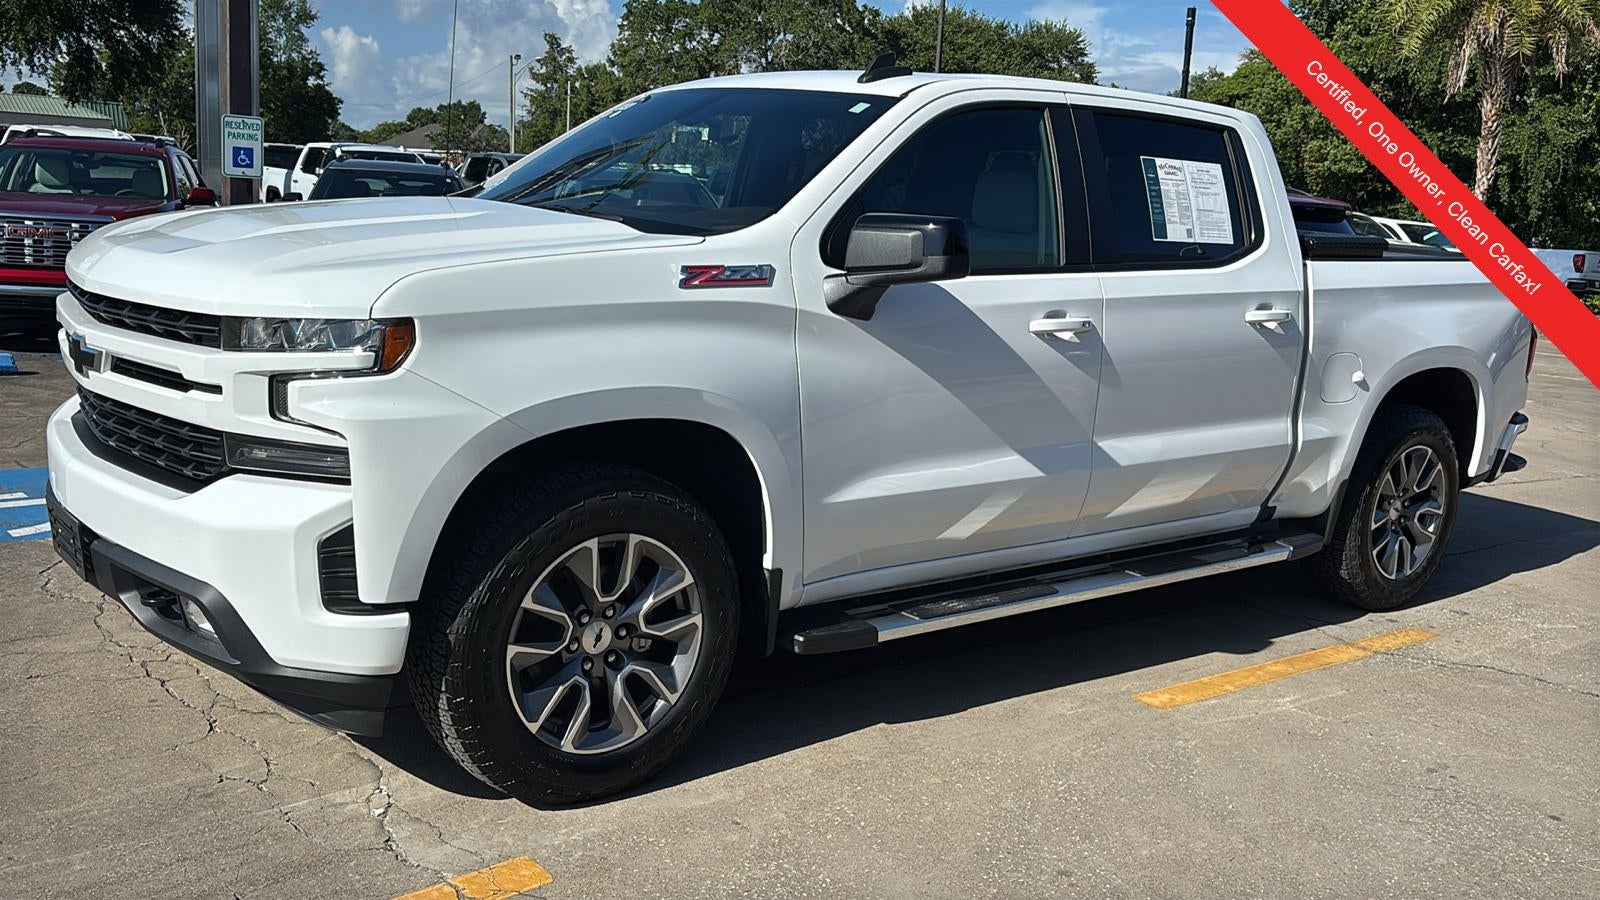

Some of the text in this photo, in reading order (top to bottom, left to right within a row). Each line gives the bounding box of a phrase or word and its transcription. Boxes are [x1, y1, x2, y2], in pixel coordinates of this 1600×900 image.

[225, 121, 260, 131] RESERVED
[227, 132, 259, 141] PARKING
[8, 225, 66, 239] GMC
[679, 265, 773, 288] Z71
